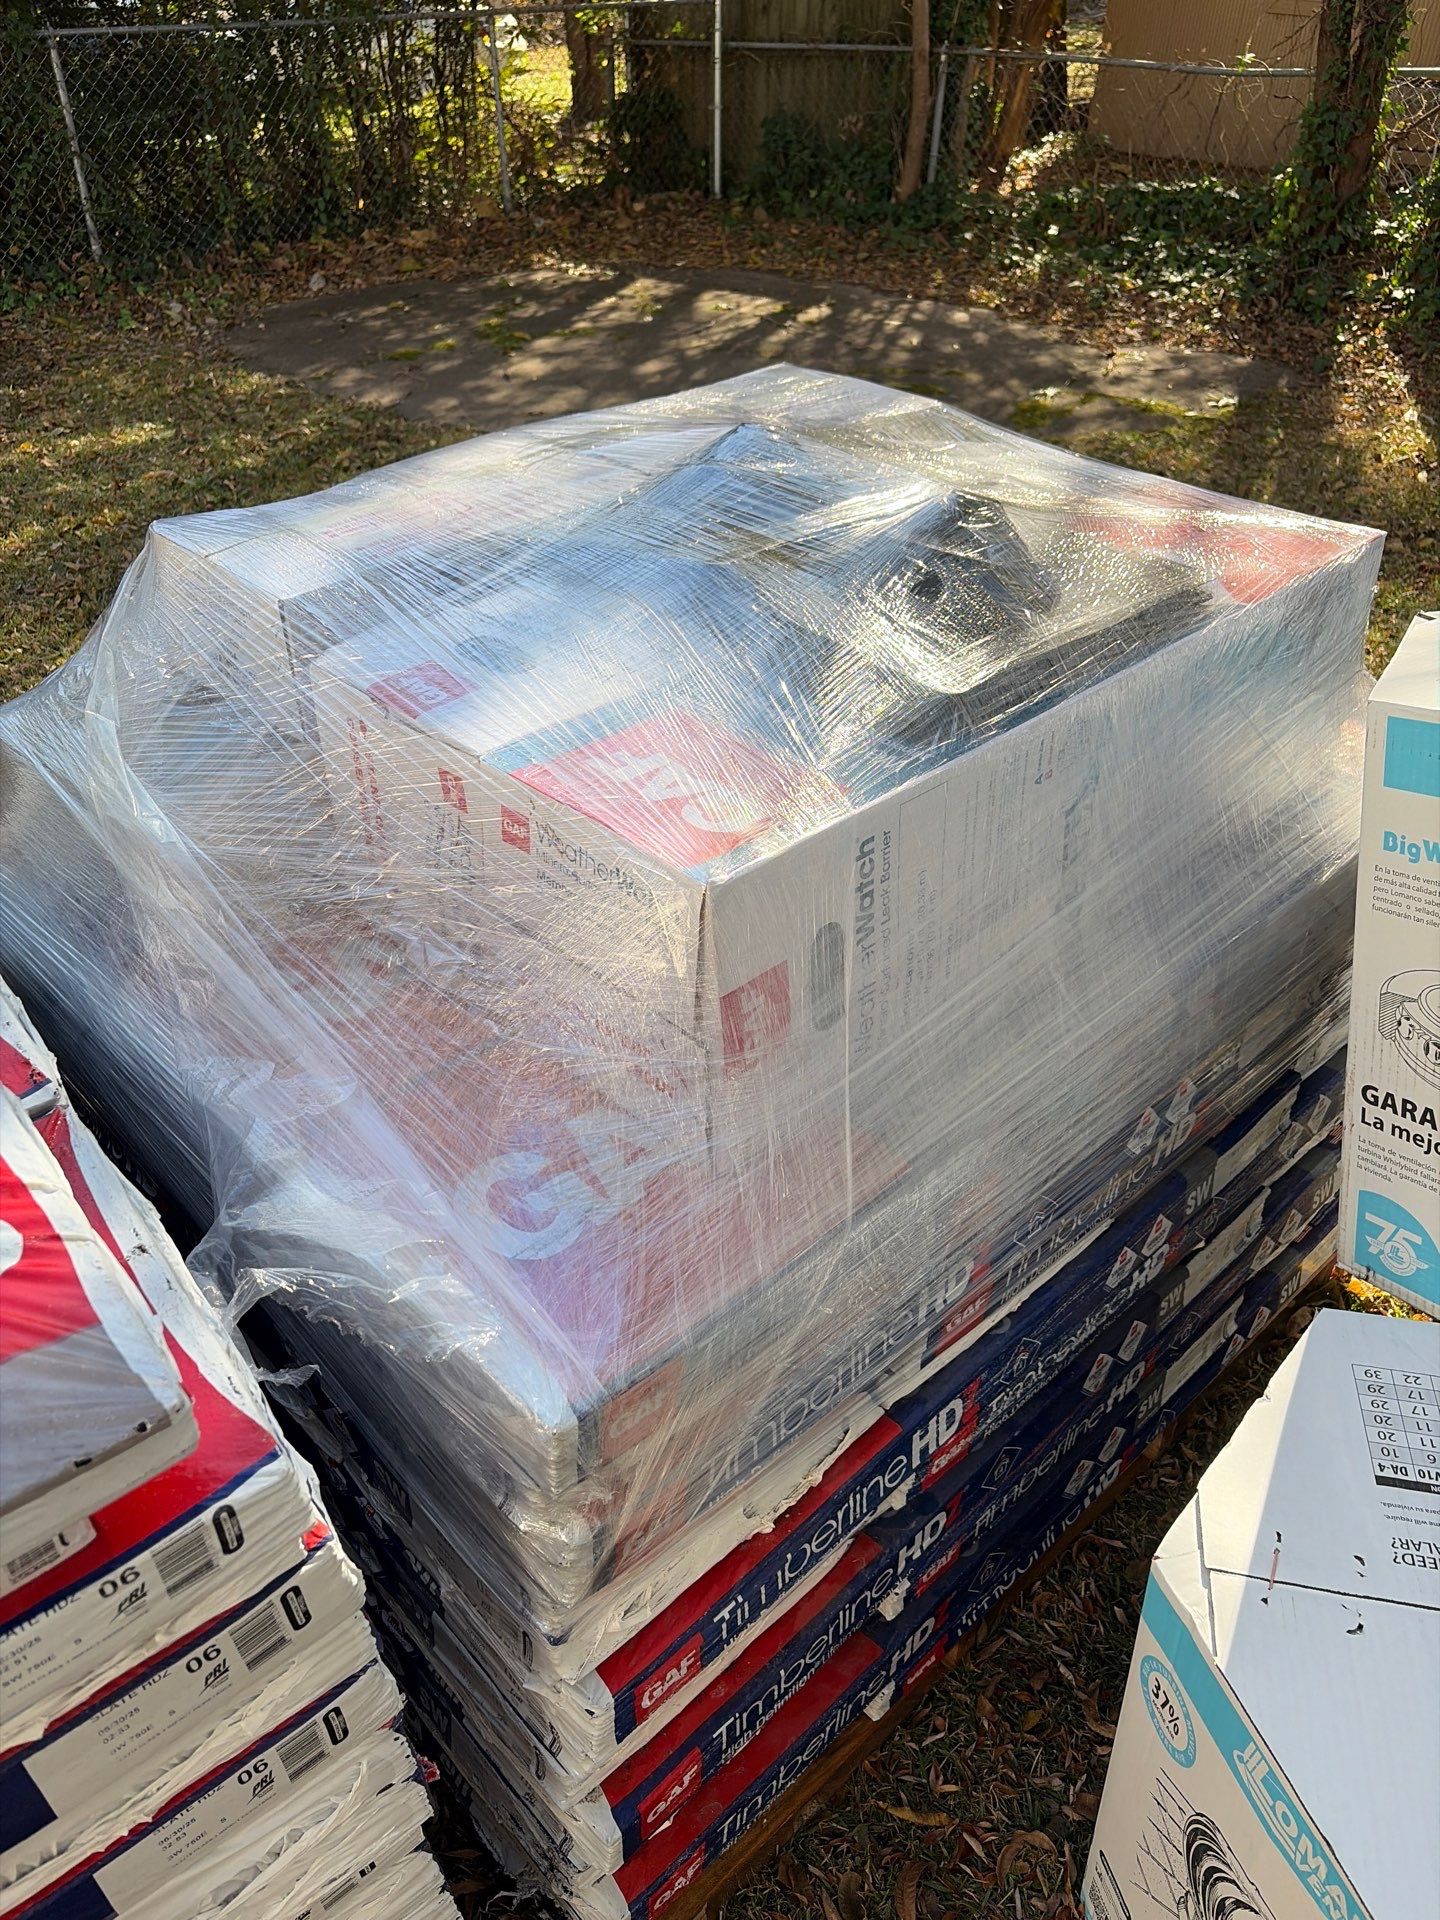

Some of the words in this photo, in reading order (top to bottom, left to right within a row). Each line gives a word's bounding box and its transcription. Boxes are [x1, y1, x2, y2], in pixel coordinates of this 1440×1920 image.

[879, 829, 892, 884] Barrier
[1374, 864, 1384, 873] En
[1385, 866, 1391, 875] la
[1392, 869, 1410, 880] toma
[1412, 874, 1421, 882] de
[1373, 875, 1383, 883] de
[1384, 878, 1397, 887] más
[1398, 881, 1411, 890] alta
[1412, 885, 1437, 897] calidad
[1373, 885, 1389, 894] pero
[1391, 889, 1423, 903] Lomanco
[1372, 895, 1403, 908] centrado
[1371, 903, 1412, 920] funcionarán
[1413, 915, 1425, 924] tan
[854, 834, 877, 1054] WeaterWatch
[1360, 1106, 1384, 1134] La
[1357, 1144, 1382, 1160] turbina
[1382, 1154, 1419, 1176] Whirlybird
[1358, 1135, 1366, 1144] La
[1368, 1139, 1386, 1152] toma
[1387, 1148, 1397, 1157] de
[1398, 1153, 1437, 1174] ventilación
[1356, 1161, 1363, 1170] la
[1363, 1165, 1393, 1184] vivienda.
[1389, 1166, 1398, 1176] La
[1398, 1172, 1428, 1189] garantía
[1428, 1184, 1438, 1194] de
[1364, 1211, 1423, 1264] 75
[1364, 1368, 1383, 1380] 39
[1403, 1374, 1422, 1386] 22
[1367, 1383, 1386, 1395] 29
[1408, 1390, 1425, 1401] 17
[1371, 1399, 1390, 1411] 29
[1412, 1405, 1429, 1416] 17
[1374, 1415, 1393, 1426] 20
[1416, 1421, 1433, 1433] 11
[1377, 1430, 1397, 1443] 20
[1420, 1436, 1437, 1449] 11
[1381, 1446, 1400, 1459] 10
[1427, 1454, 1437, 1465] 6
[1378, 1462, 1409, 1477] DA-4
[1381, 1501, 1414, 1512] vivienda.
[1384, 1514, 1413, 1523] require.
[98, 1565, 141, 1598] 06
[184, 1643, 223, 1674] 06
[713, 1567, 896, 1752] Timberline
[202, 1657, 230, 1688] PRI
[641, 1649, 697, 1709] GAF
[721, 1729, 753, 1765] High
[755, 1665, 817, 1729] Definition
[1151, 1676, 1180, 1736] 37%
[717, 1670, 887, 1846] Timberline
[237, 1758, 269, 1785] 06
[251, 1769, 276, 1797] PRI
[646, 1763, 698, 1824] GAF
[653, 1857, 704, 1911] GAF
